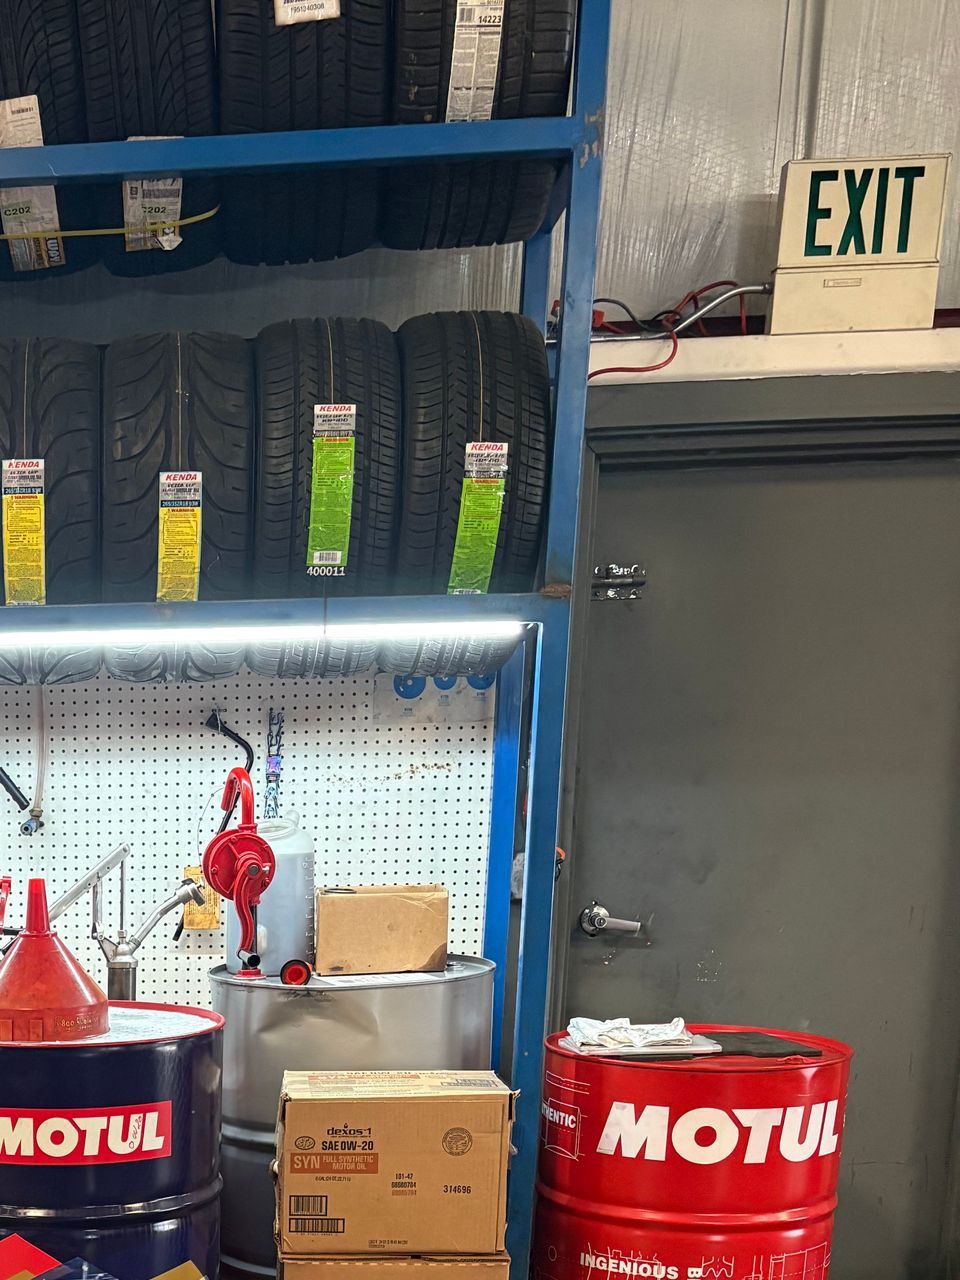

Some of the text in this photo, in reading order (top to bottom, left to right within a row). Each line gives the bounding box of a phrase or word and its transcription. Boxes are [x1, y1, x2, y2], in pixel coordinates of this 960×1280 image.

[478, 15, 502, 24] 14223
[4, 205, 31, 217] C202
[804, 166, 926, 257] EXIT
[470, 443, 504, 452] KENDA
[8, 461, 40, 469] KENDA
[165, 473, 198, 481] KENDA
[307, 566, 346, 577] 400011
[596, 1099, 839, 1165] MOTUL
[321, 1140, 374, 1151] SAE 0W-20
[293, 1155, 374, 1169] SYN FULL SYNTHETIC
[443, 1184, 472, 1194] 314696
[580, 1252, 679, 1280] INGENIOUS
